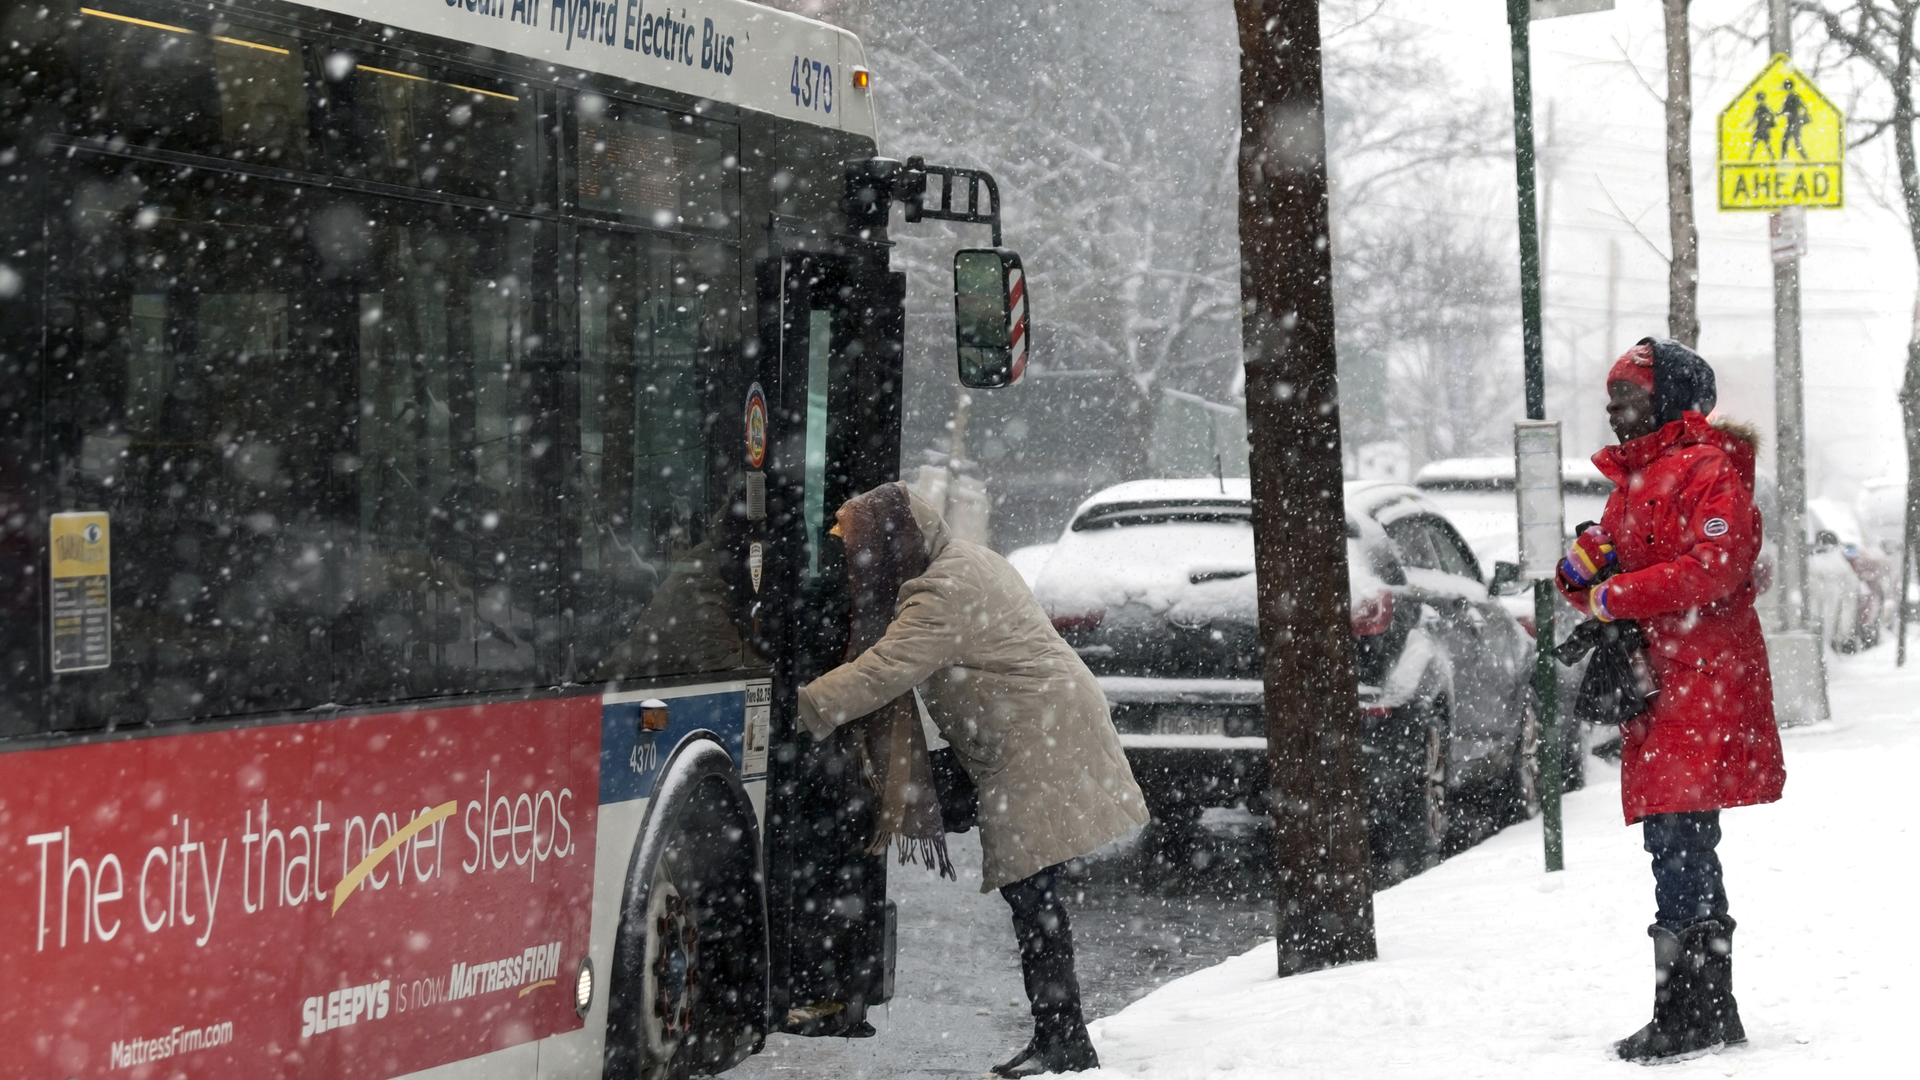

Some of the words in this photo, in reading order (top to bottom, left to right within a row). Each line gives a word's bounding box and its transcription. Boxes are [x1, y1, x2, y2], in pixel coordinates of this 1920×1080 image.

[550, 0, 618, 51] Hybrid
[624, 0, 695, 66] Electric
[701, 17, 735, 76] Bus
[790, 55, 833, 114] 4370
[1733, 172, 1830, 199] AHEAD
[630, 742, 657, 774] 4370
[27, 826, 123, 952] The
[139, 814, 228, 946] city
[242, 799, 330, 914] that
[342, 804, 448, 891] never
[462, 769, 576, 883] sleeps.
[302, 979, 390, 1038] SLEEPYS
[395, 977, 408, 1014] is
[411, 974, 446, 1012] now
[110, 1020, 233, 1071] MattressFirm.com
